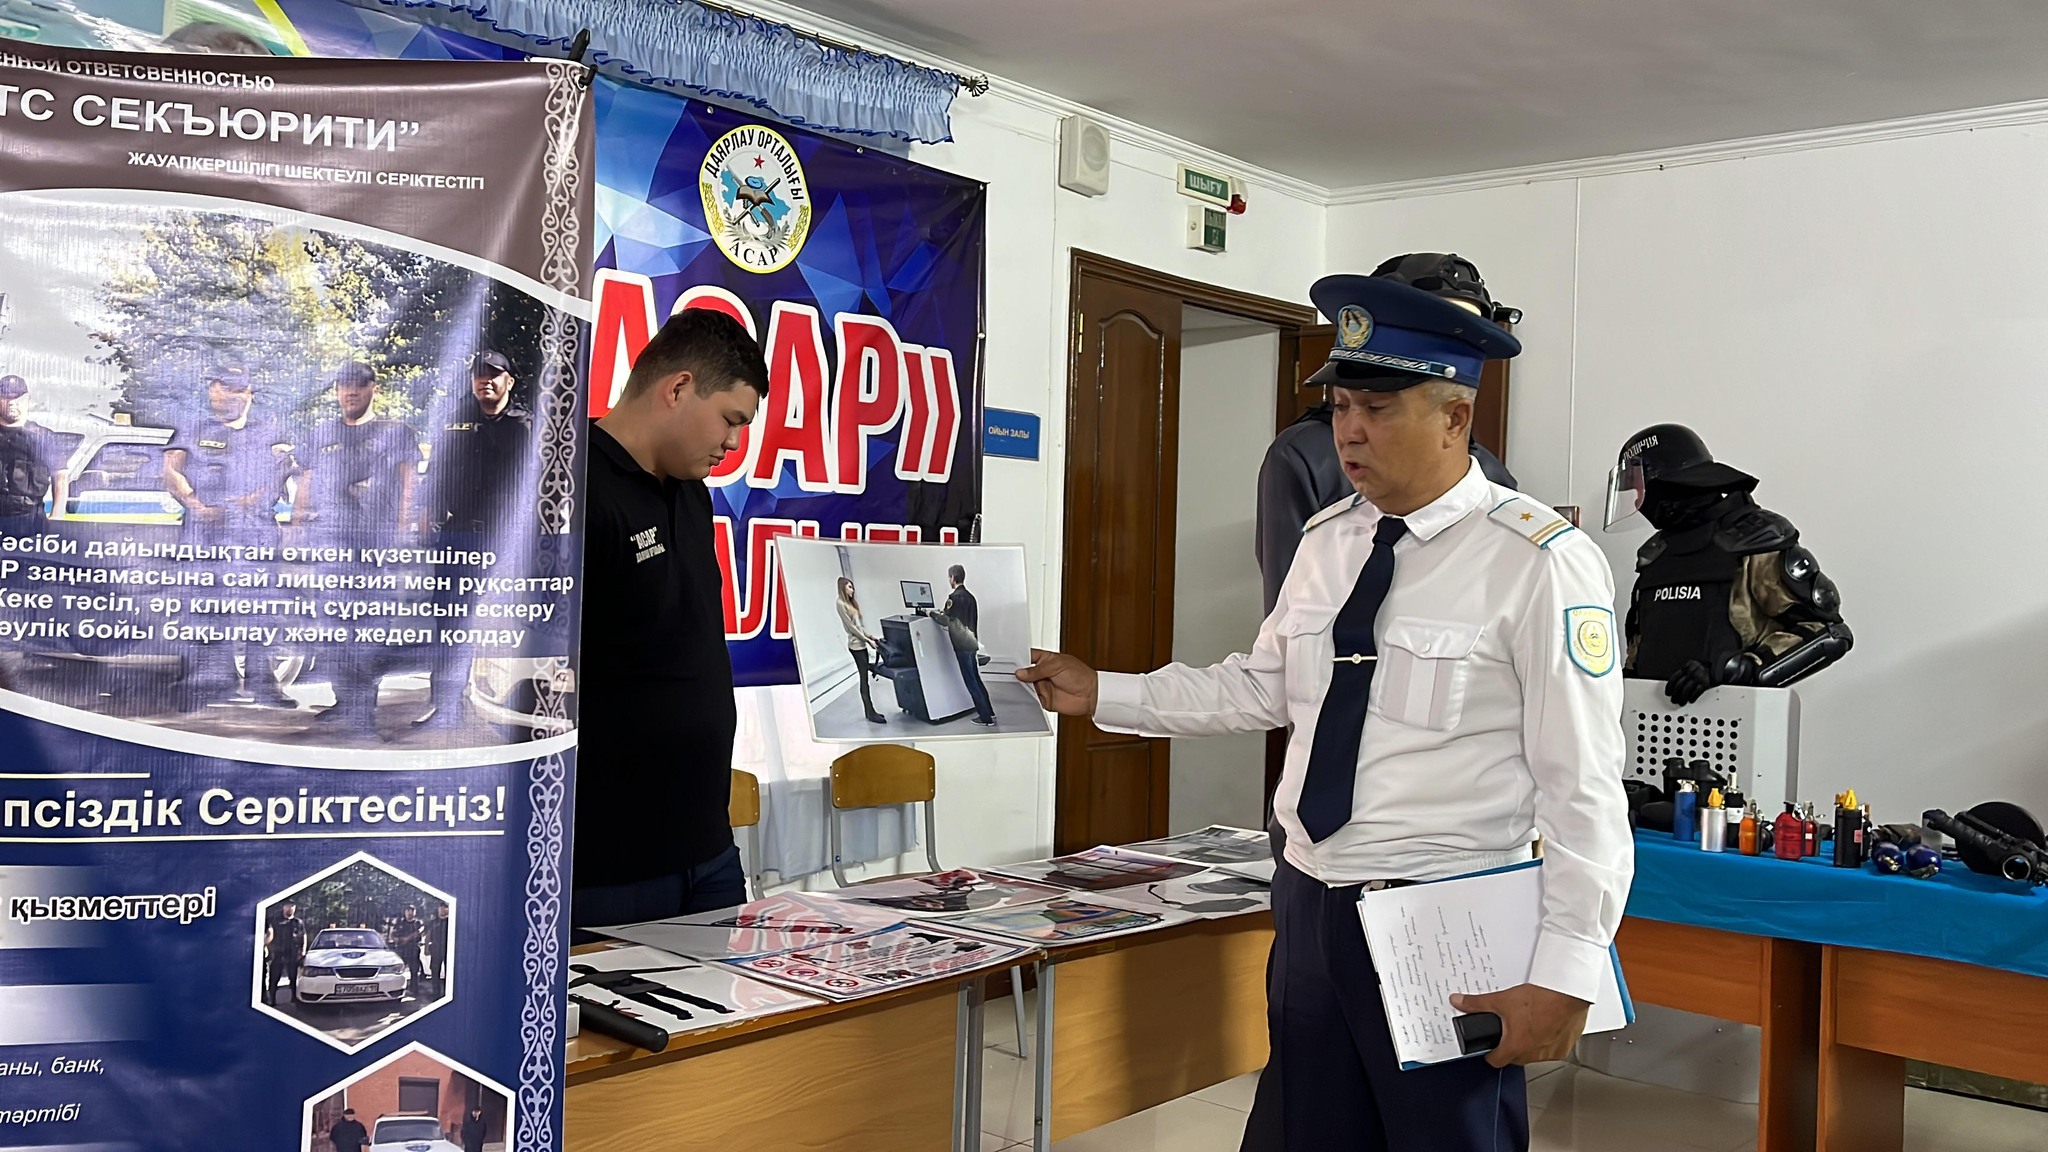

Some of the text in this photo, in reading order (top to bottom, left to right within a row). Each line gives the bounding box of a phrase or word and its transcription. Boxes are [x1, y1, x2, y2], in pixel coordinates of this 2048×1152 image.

[66, 60, 275, 91] ОТВЕТСВЕННОСТЬЮ
[284, 164, 372, 185] ШЕКТЕУЛІ
[704, 128, 805, 201] ДАЯРЛАУ ОРТАЛЫҒЫ
[1189, 174, 1223, 196] ШЫҒУ
[729, 241, 779, 267] АСАР
[988, 425, 1030, 439] ОЙЫН ЗАЛЫ
[0, 531, 496, 569] әсіби дайындықтан өткен күзетшілер
[27, 565, 214, 587] заңнамасына
[222, 568, 268, 588] сай
[276, 573, 396, 591] лицензия
[404, 576, 451, 591] мен
[459, 576, 574, 595] рұқсаттар
[1654, 586, 1701, 602] POLISIA
[62, 592, 141, 615] тәсіл,
[150, 598, 181, 617] әр
[189, 596, 317, 618] клиенттің
[324, 600, 468, 620] сұранысын
[475, 603, 555, 621] ескеру
[78, 618, 154, 640] бойы
[162, 621, 276, 646] бақылау
[284, 627, 347, 642] және
[355, 627, 432, 646] жедел
[440, 628, 525, 648] қолдау
[4, 786, 506, 833] псіздік Серіктесіңіз!
[10, 886, 217, 924] қызметтері
[51, 1056, 104, 1075] банк,
